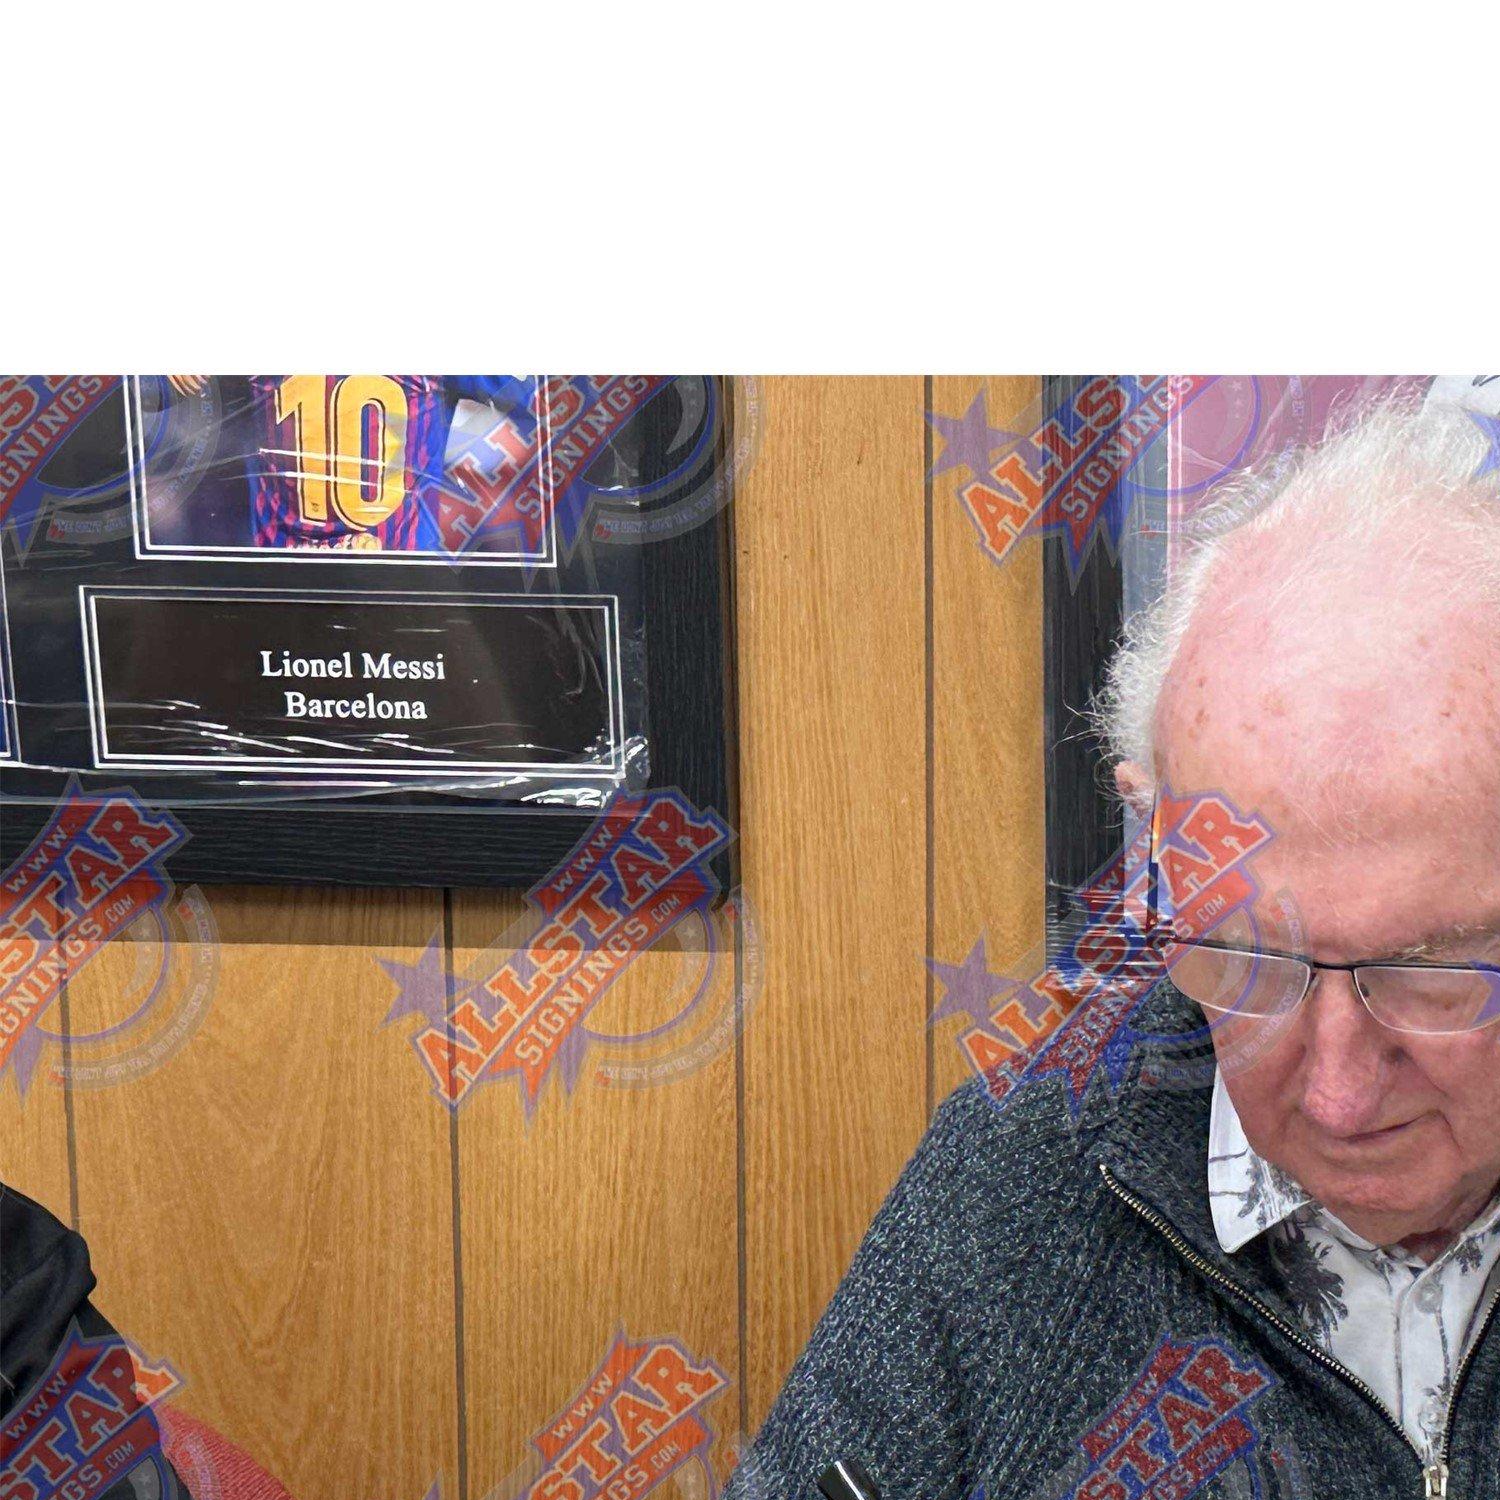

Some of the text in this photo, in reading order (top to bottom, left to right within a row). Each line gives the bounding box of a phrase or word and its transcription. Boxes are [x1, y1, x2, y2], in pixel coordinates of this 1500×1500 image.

[275, 375, 408, 531] 10
[260, 651, 446, 680] Lionel Messi
[284, 691, 428, 720] Barcelona
